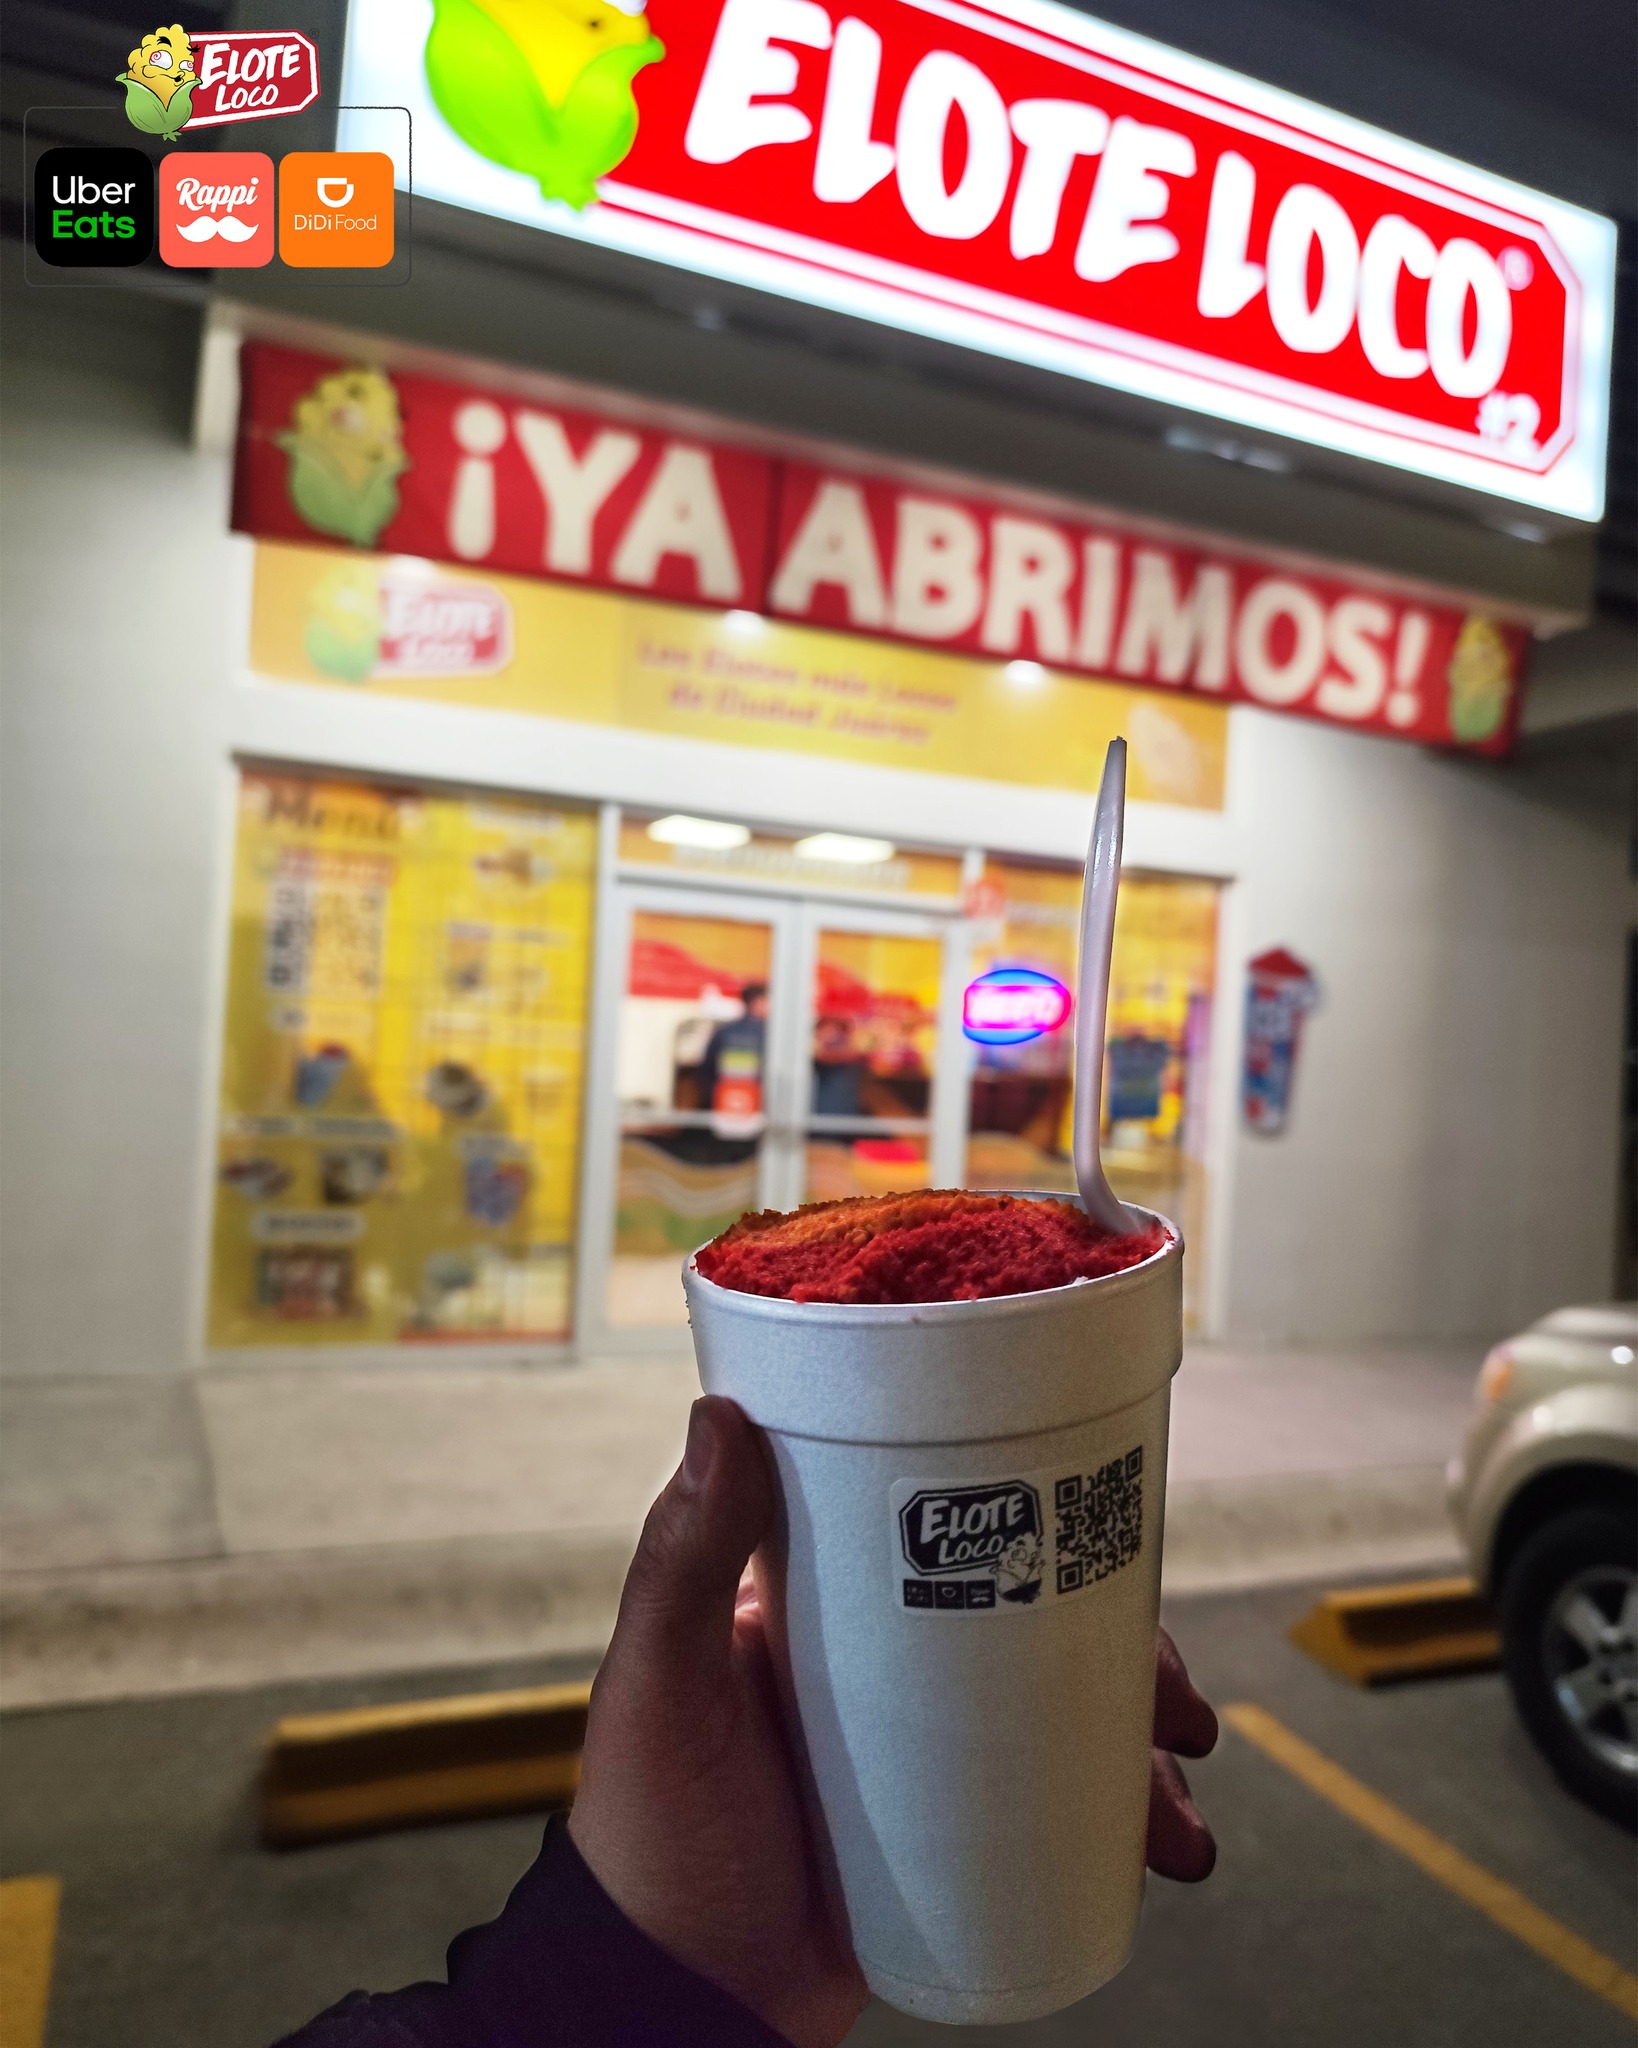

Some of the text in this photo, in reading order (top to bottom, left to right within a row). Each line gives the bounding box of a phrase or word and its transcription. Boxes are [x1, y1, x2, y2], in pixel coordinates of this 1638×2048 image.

[685, 0, 1513, 399] ELOTE LOCO
[447, 399, 1430, 729] ¡YA ABRIMOS!
[920, 1492, 1025, 1544] ELOTE
[938, 1533, 1004, 1565] LOCO
